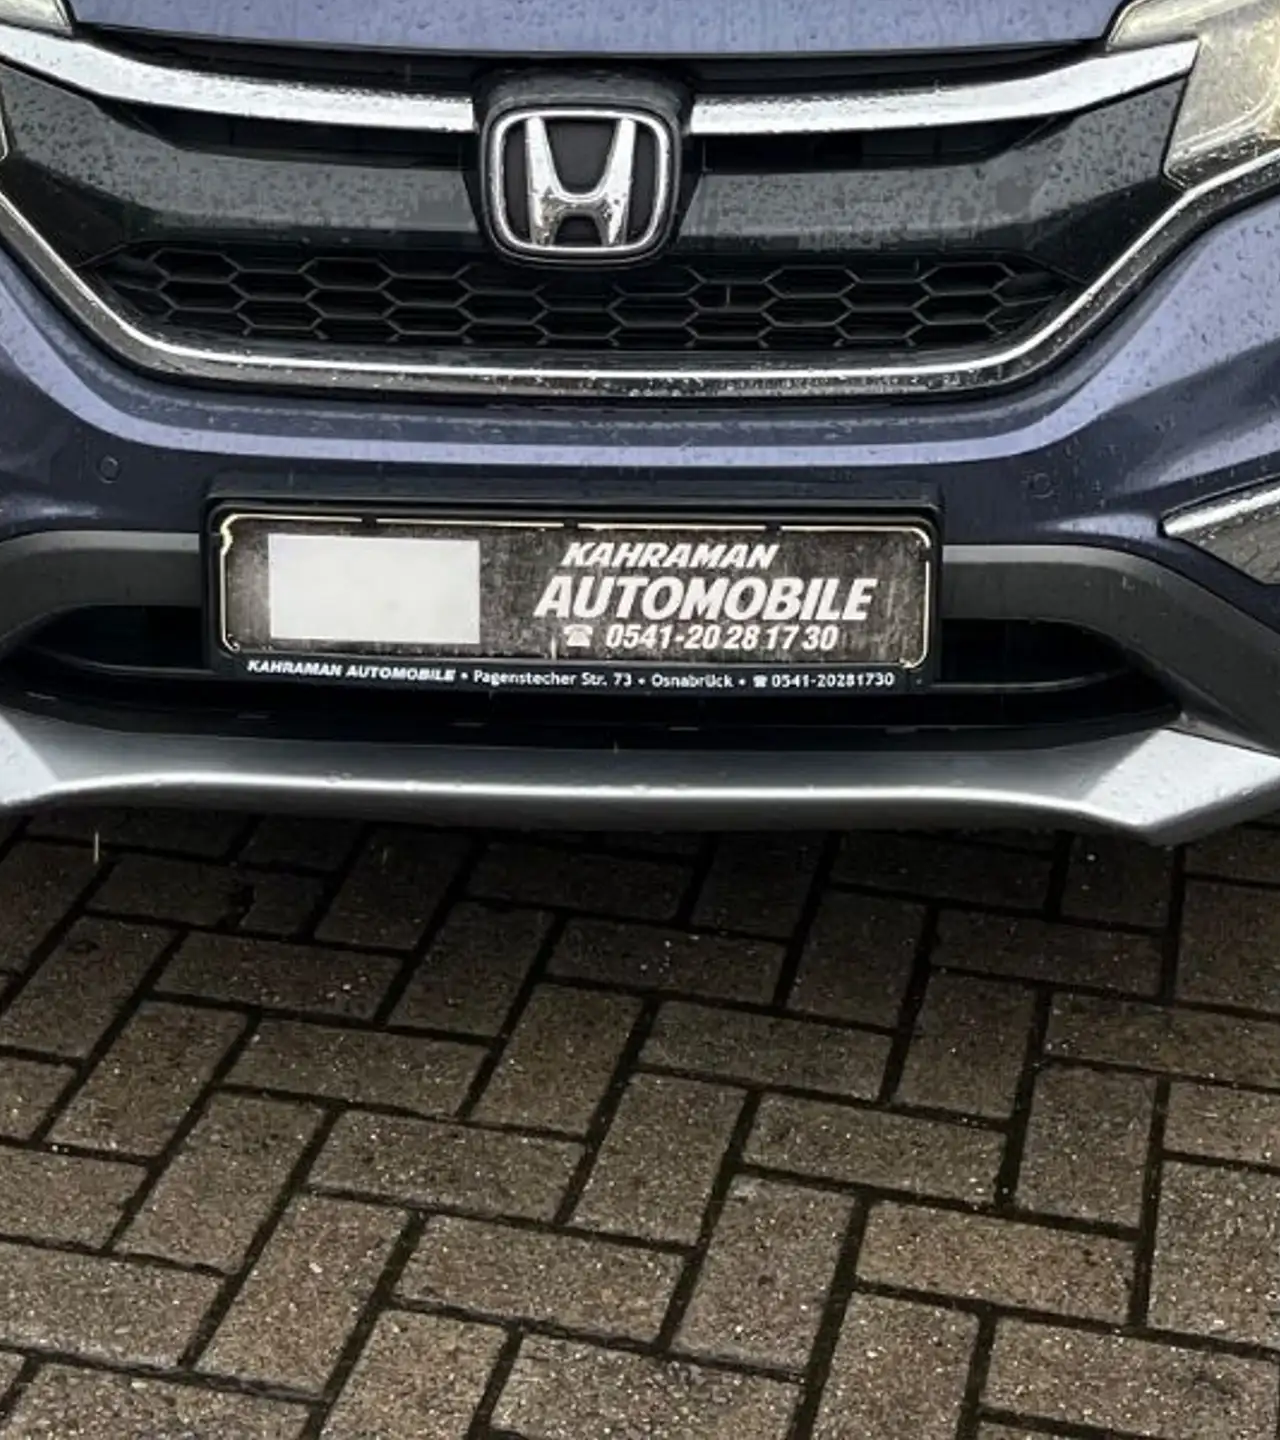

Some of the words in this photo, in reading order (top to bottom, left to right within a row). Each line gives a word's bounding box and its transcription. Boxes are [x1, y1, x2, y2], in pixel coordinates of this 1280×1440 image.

[561, 542, 780, 569] KAHRAMAN
[533, 576, 878, 621] AUTOMOBILE
[247, 659, 341, 678] KAHRAMAN
[345, 666, 456, 682] AUTOMOBILE
[473, 669, 577, 687] Pagenstecher
[581, 672, 608, 687] Str.
[614, 673, 632, 687] 73
[651, 672, 733, 689] Osnabrück
[771, 673, 895, 689] 0541-20281730
